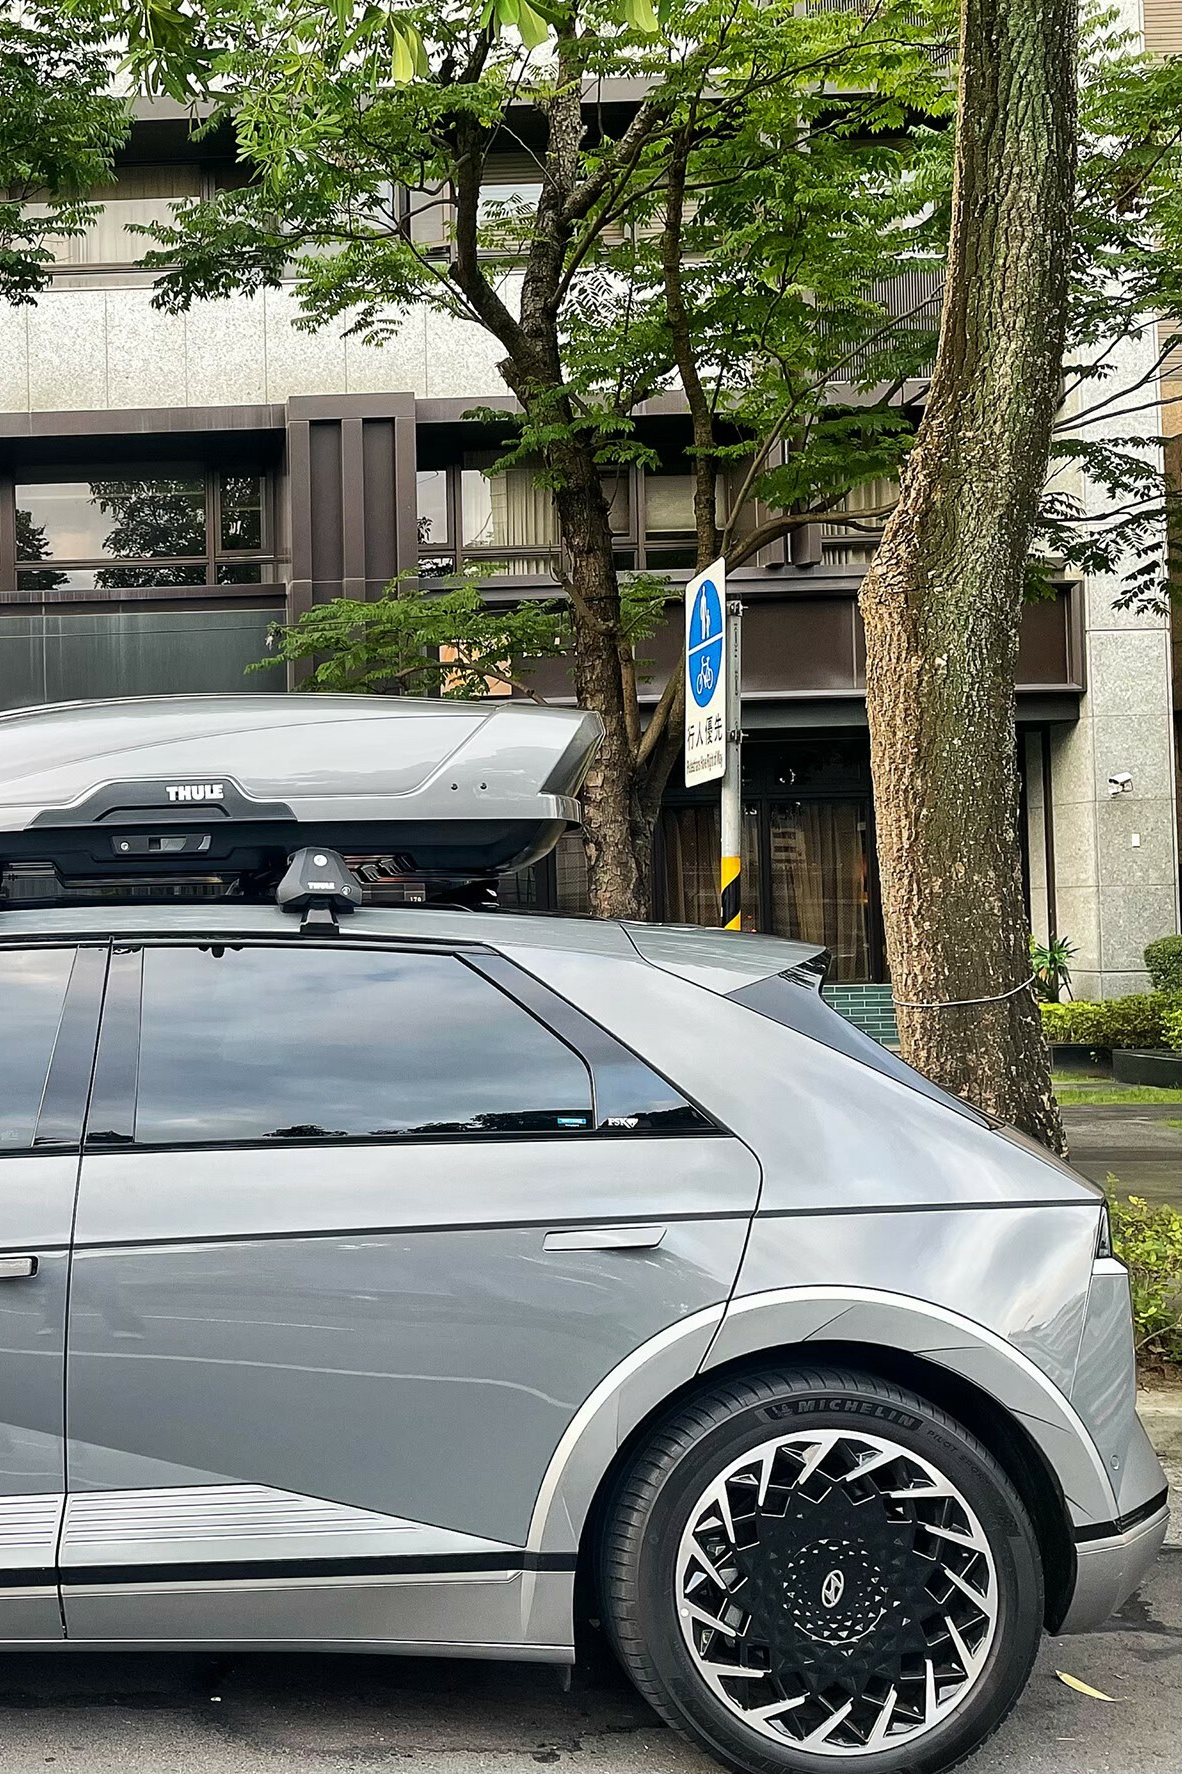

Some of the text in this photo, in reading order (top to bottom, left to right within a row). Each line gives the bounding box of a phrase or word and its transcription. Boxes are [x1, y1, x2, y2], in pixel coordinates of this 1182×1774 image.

[687, 713, 723, 752] 行人優先
[166, 784, 224, 801] THULE
[307, 882, 335, 890] THULE
[798, 1399, 917, 1428] MICHELIN
[927, 1430, 958, 1452] PILOT
